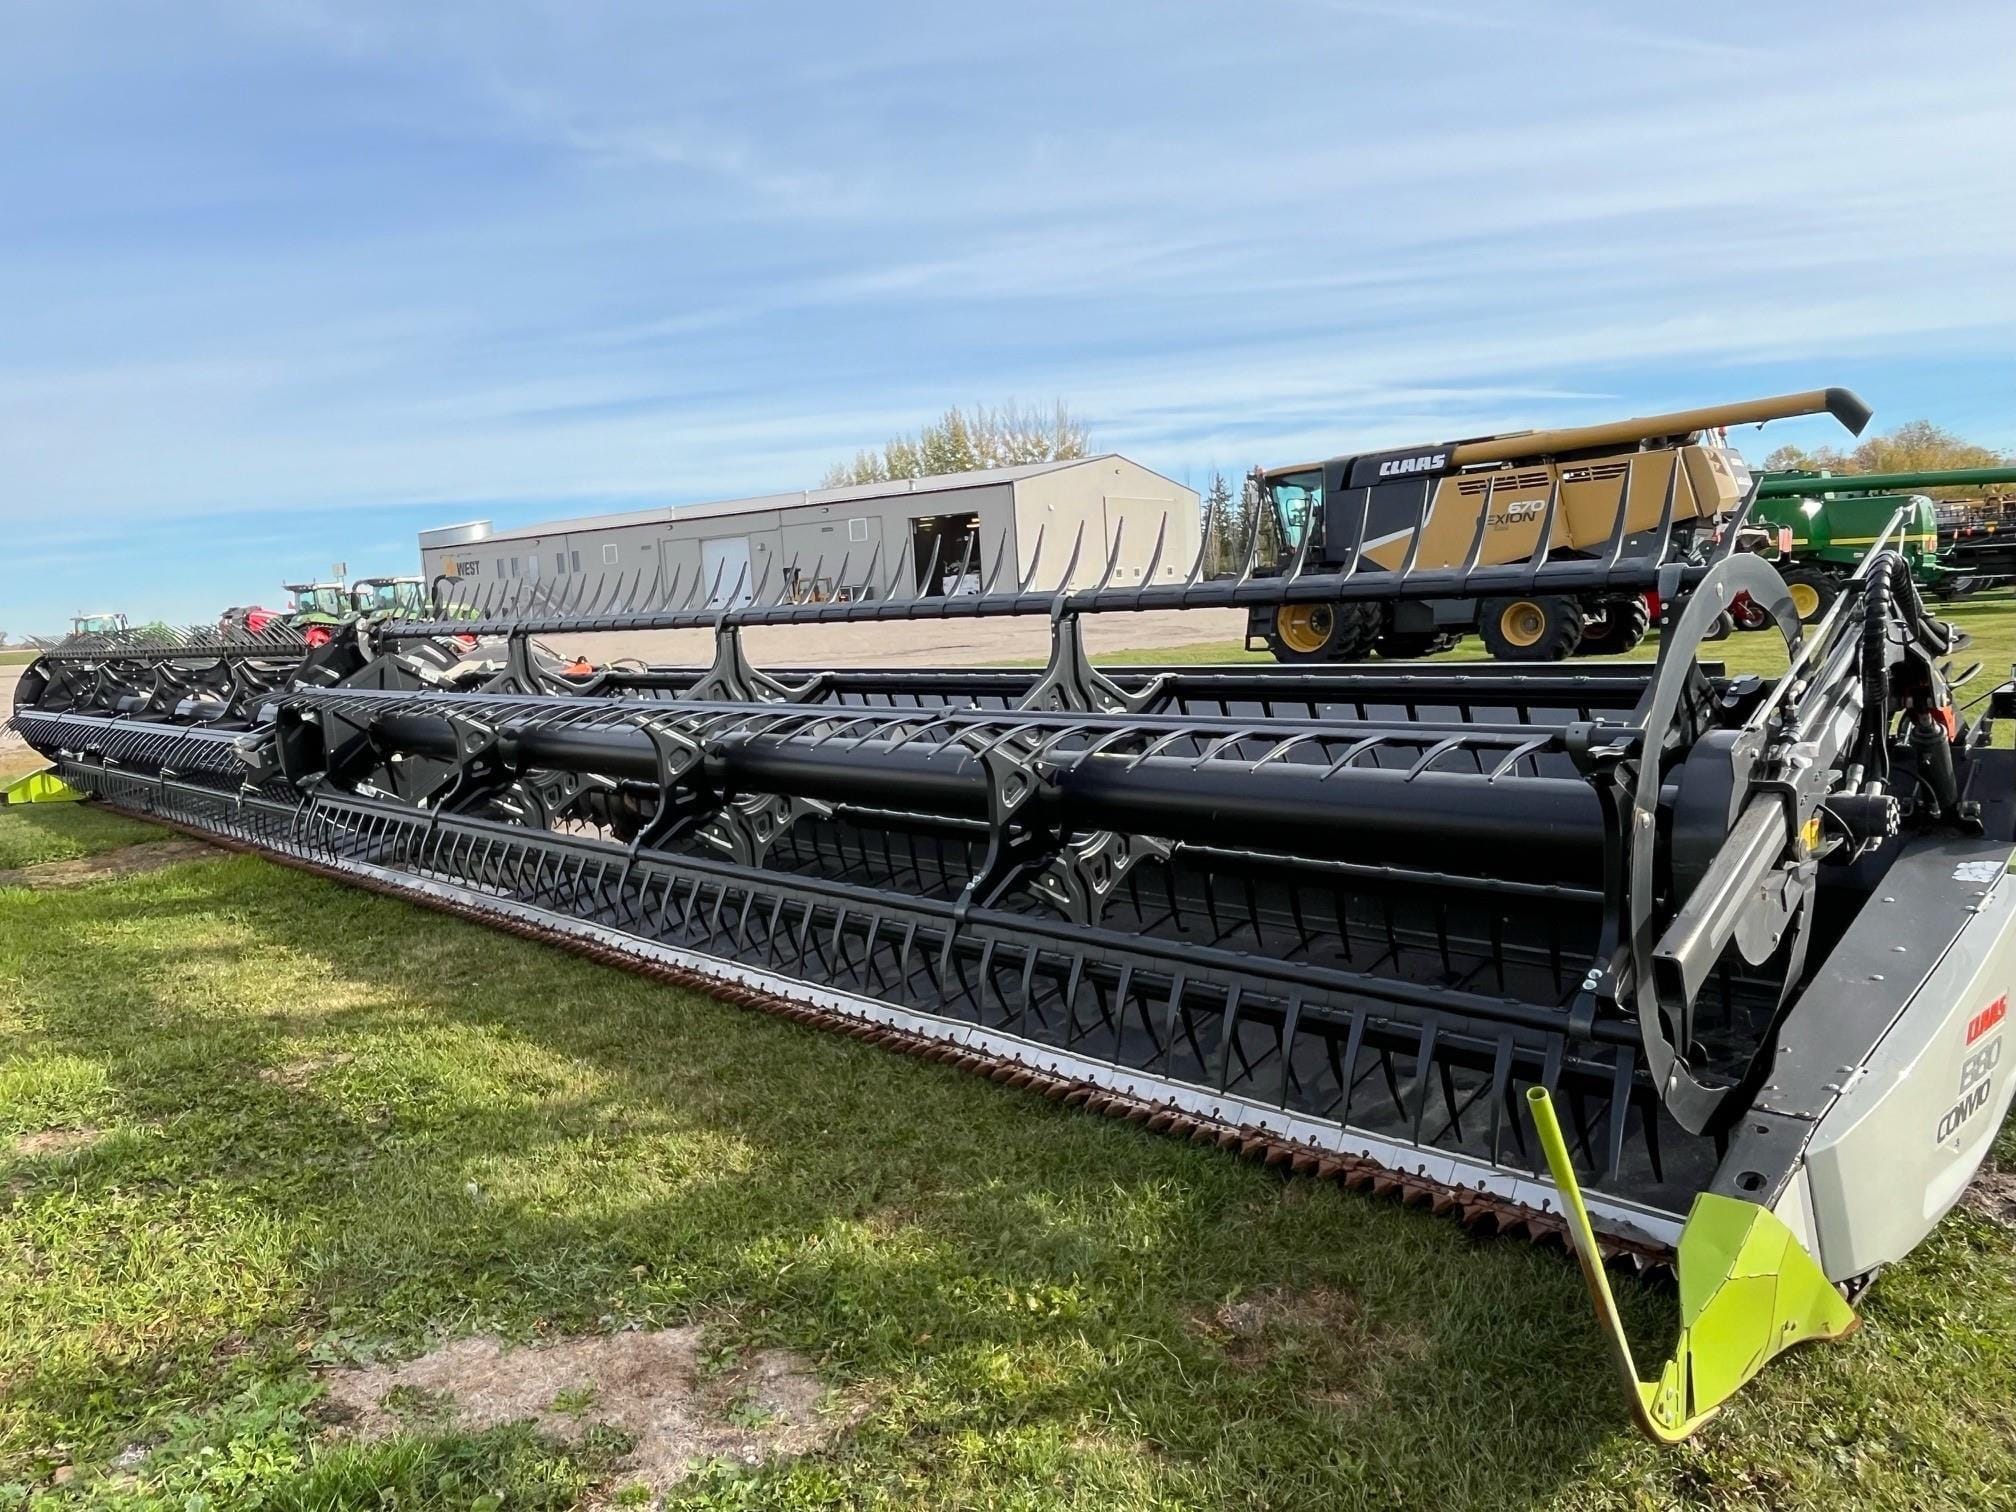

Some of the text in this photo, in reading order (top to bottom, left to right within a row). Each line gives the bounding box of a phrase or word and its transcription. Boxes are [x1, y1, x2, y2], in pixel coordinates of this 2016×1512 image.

[1379, 454, 1446, 476] CLAAS
[1508, 500, 1546, 514] 670
[456, 560, 480, 577] WEST
